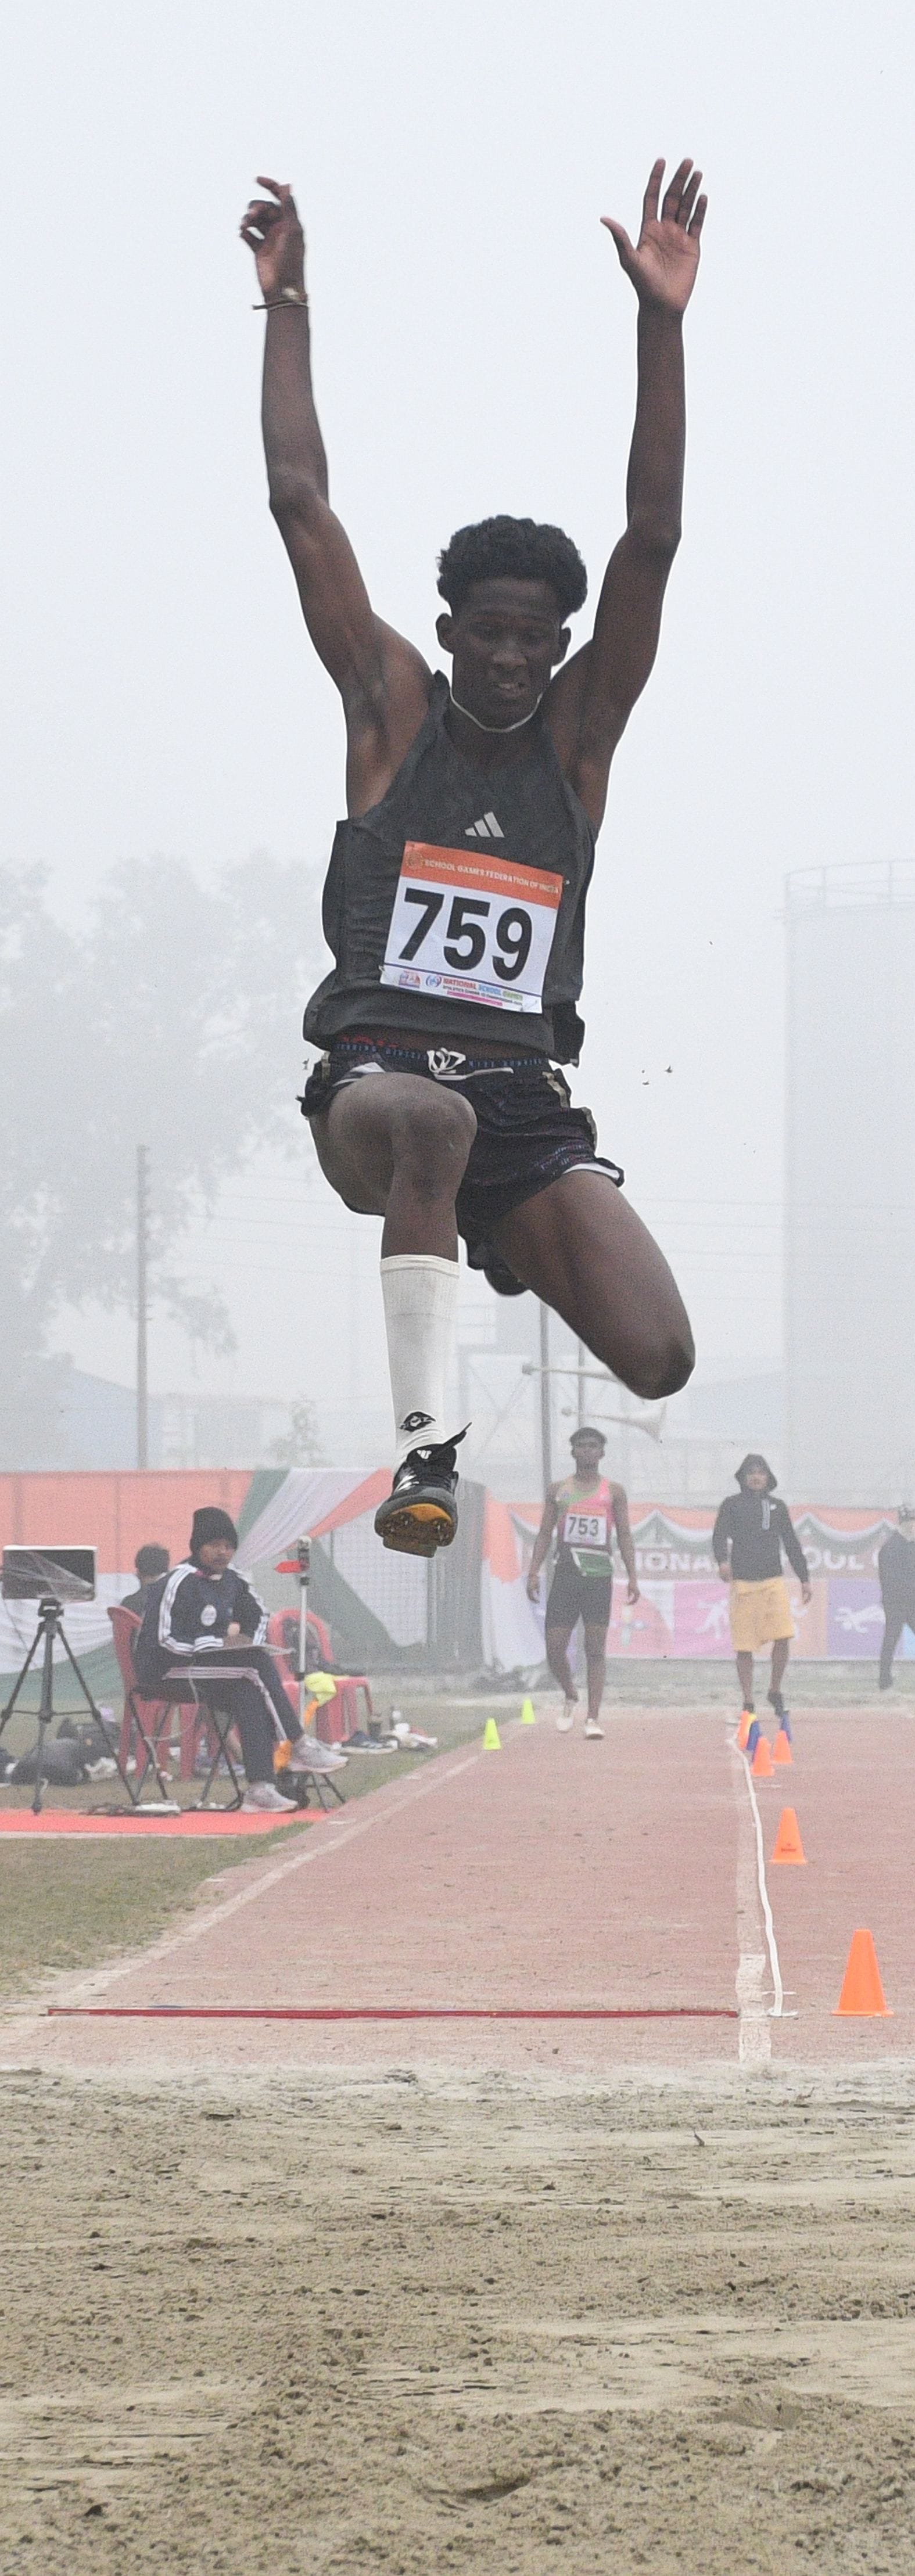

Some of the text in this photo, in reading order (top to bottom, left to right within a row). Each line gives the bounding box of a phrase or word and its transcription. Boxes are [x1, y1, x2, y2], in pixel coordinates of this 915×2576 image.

[425, 858, 559, 893] SCHOOL GAMES FEDERATION OF INDIA
[399, 887, 533, 982] 759
[443, 978, 476, 990] NATIONAL
[569, 1516, 599, 1536] 753
